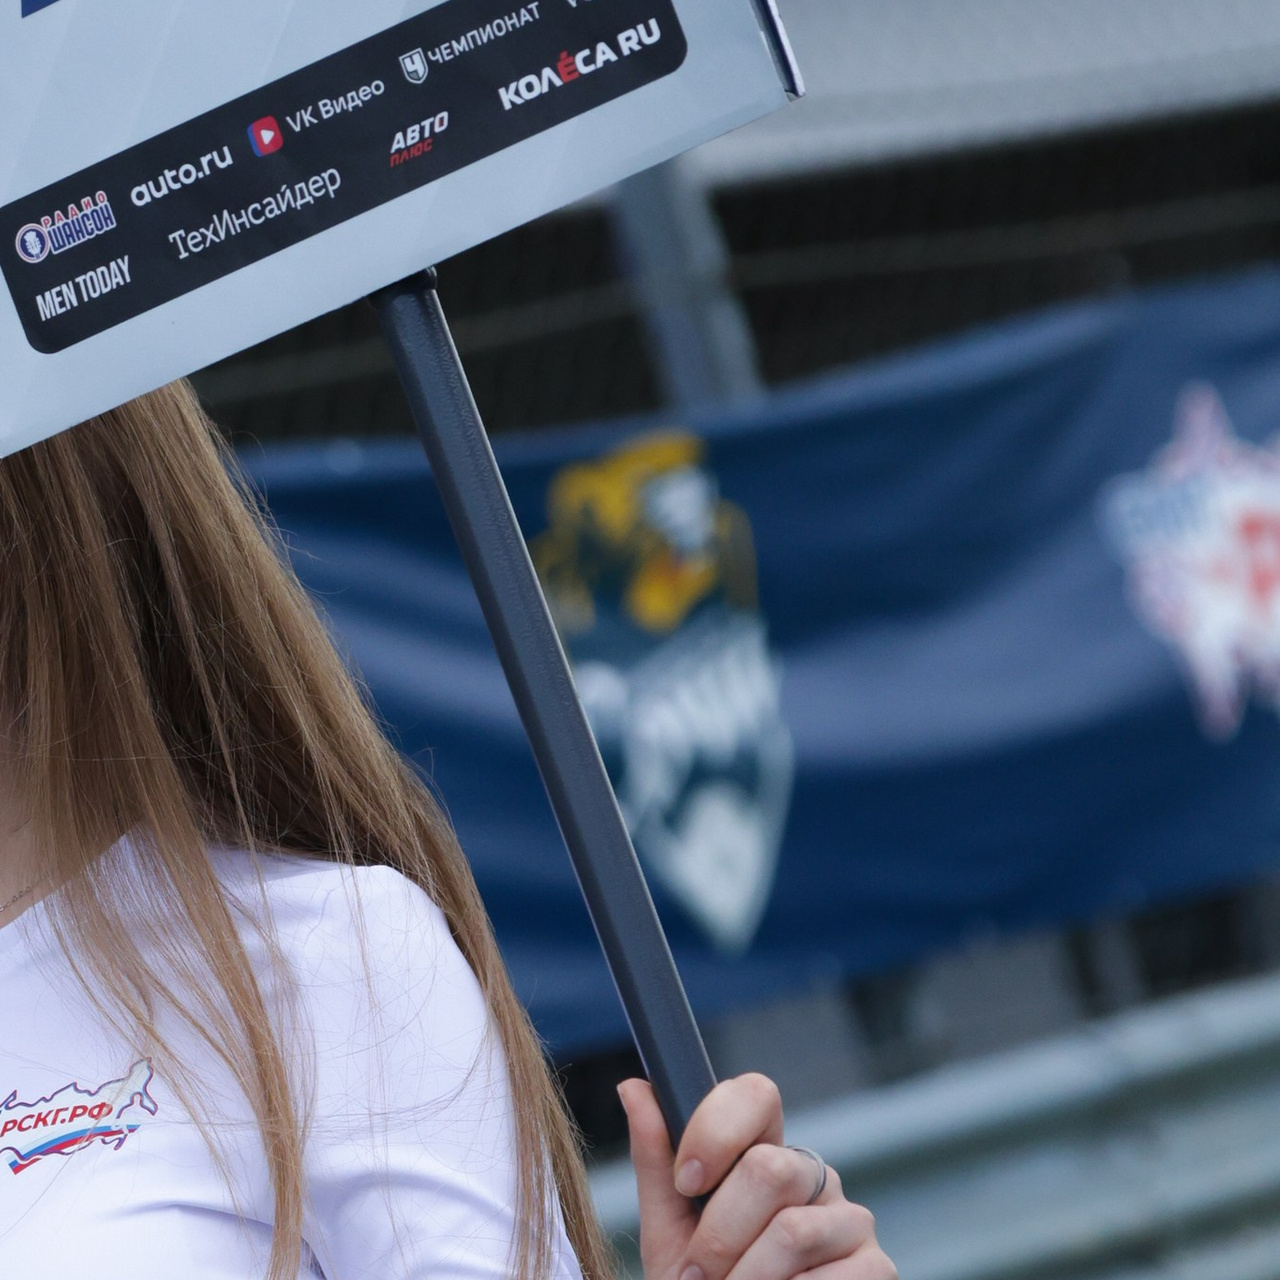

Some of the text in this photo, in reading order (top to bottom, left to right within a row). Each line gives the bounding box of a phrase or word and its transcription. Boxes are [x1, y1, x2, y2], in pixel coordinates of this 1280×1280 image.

[427, 1, 541, 64] ЧЕМПИОНАТ
[617, 17, 662, 57] RU
[285, 79, 385, 133] VK Видео
[390, 110, 449, 154] АВТО
[130, 146, 234, 207] auto.ru
[390, 138, 433, 168] ПЛЮС
[46, 202, 116, 254] ШАНСОН
[168, 167, 342, 260] ТехИнсайдер
[36, 255, 132, 322] MEN TODAY
[0, 1100, 114, 1139] РСКГ.РФ
